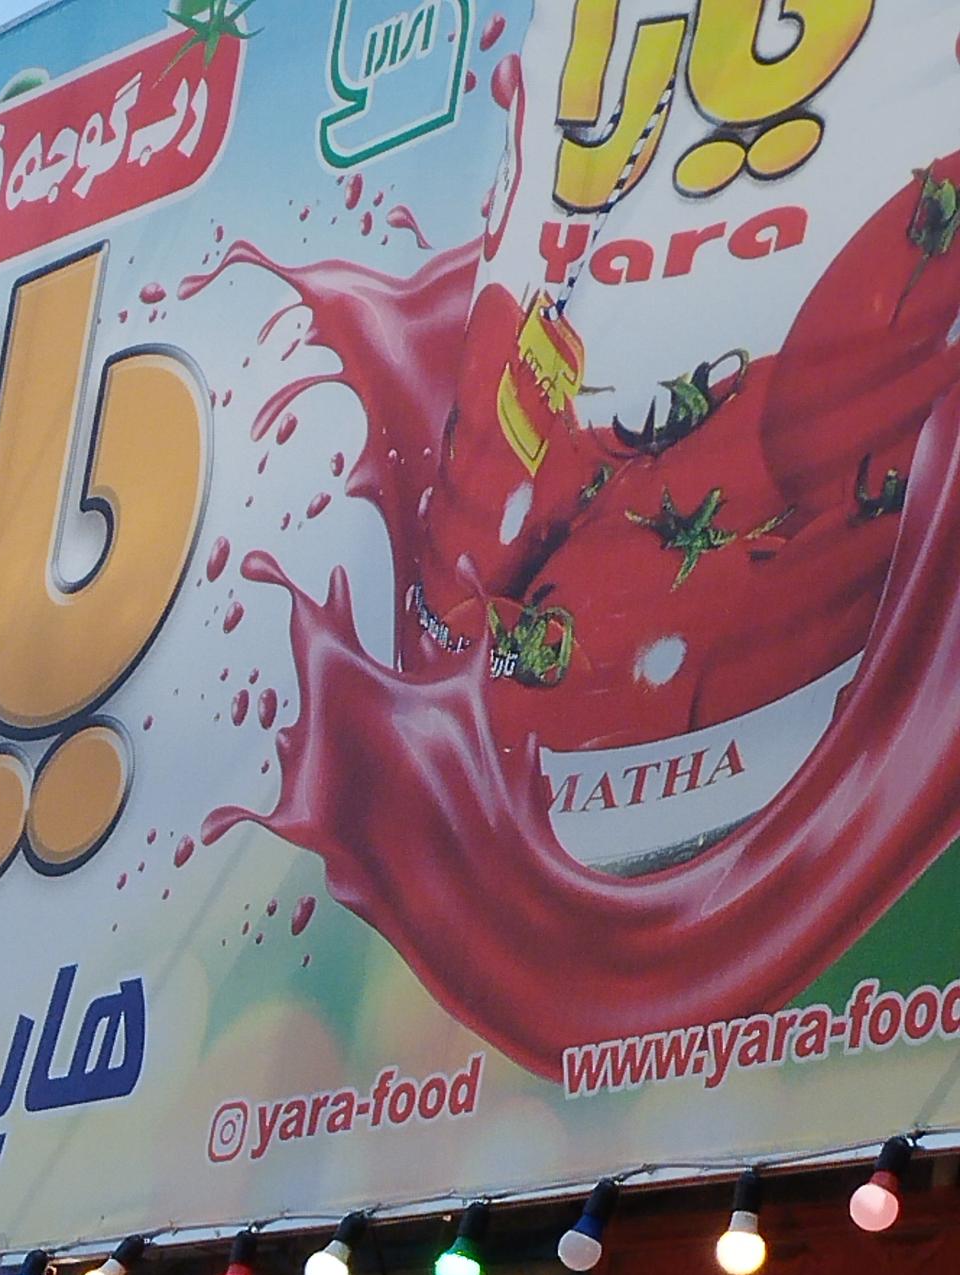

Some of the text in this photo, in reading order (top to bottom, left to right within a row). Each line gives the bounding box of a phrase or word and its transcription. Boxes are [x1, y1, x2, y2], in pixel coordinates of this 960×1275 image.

[128, 75, 209, 168] رب
[539, 206, 808, 286] Yara
[249, 1054, 484, 1161] yara-food
